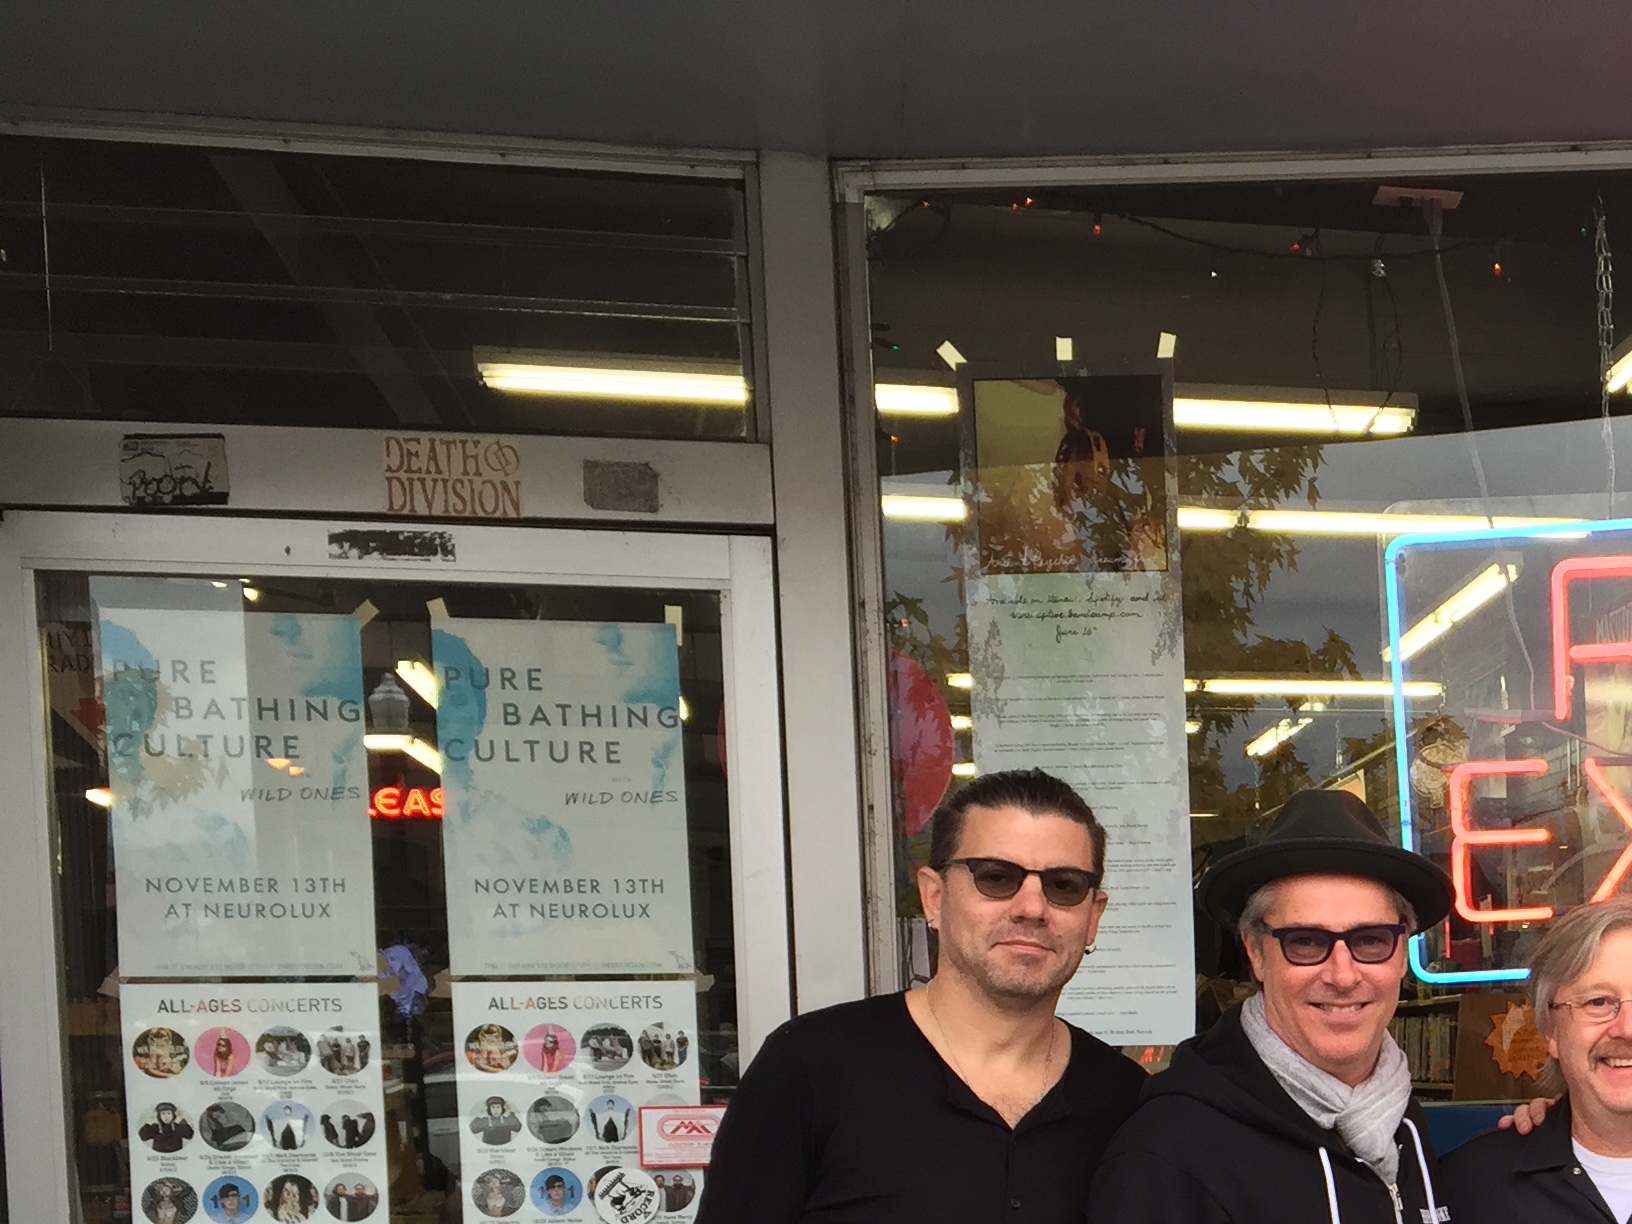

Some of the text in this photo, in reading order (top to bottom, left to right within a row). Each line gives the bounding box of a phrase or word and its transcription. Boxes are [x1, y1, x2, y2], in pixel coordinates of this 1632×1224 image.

[384, 436, 483, 477] DEATH
[385, 475, 521, 518] DIVISION
[112, 659, 216, 684] PURE
[444, 666, 544, 691] PURE
[174, 697, 361, 722] BATHING
[502, 703, 679, 729] BATHING
[112, 733, 300, 759] CULTURE
[444, 738, 622, 764] CULTURE
[240, 786, 360, 802] WILD ONES
[367, 786, 444, 818] EAS
[565, 790, 679, 806] WILD ONES
[145, 877, 347, 894] NOVEMBER 13TH
[474, 878, 665, 894] NOVEMBER 13TH
[165, 903, 332, 919] AT NEUROLUX
[493, 903, 651, 919] AT NEUROLUX
[157, 997, 343, 1014] ALL-AGES CONCERTS
[488, 995, 663, 1011] ALL-AGES CONCERTS
[619, 1189, 656, 1224] RECORD
